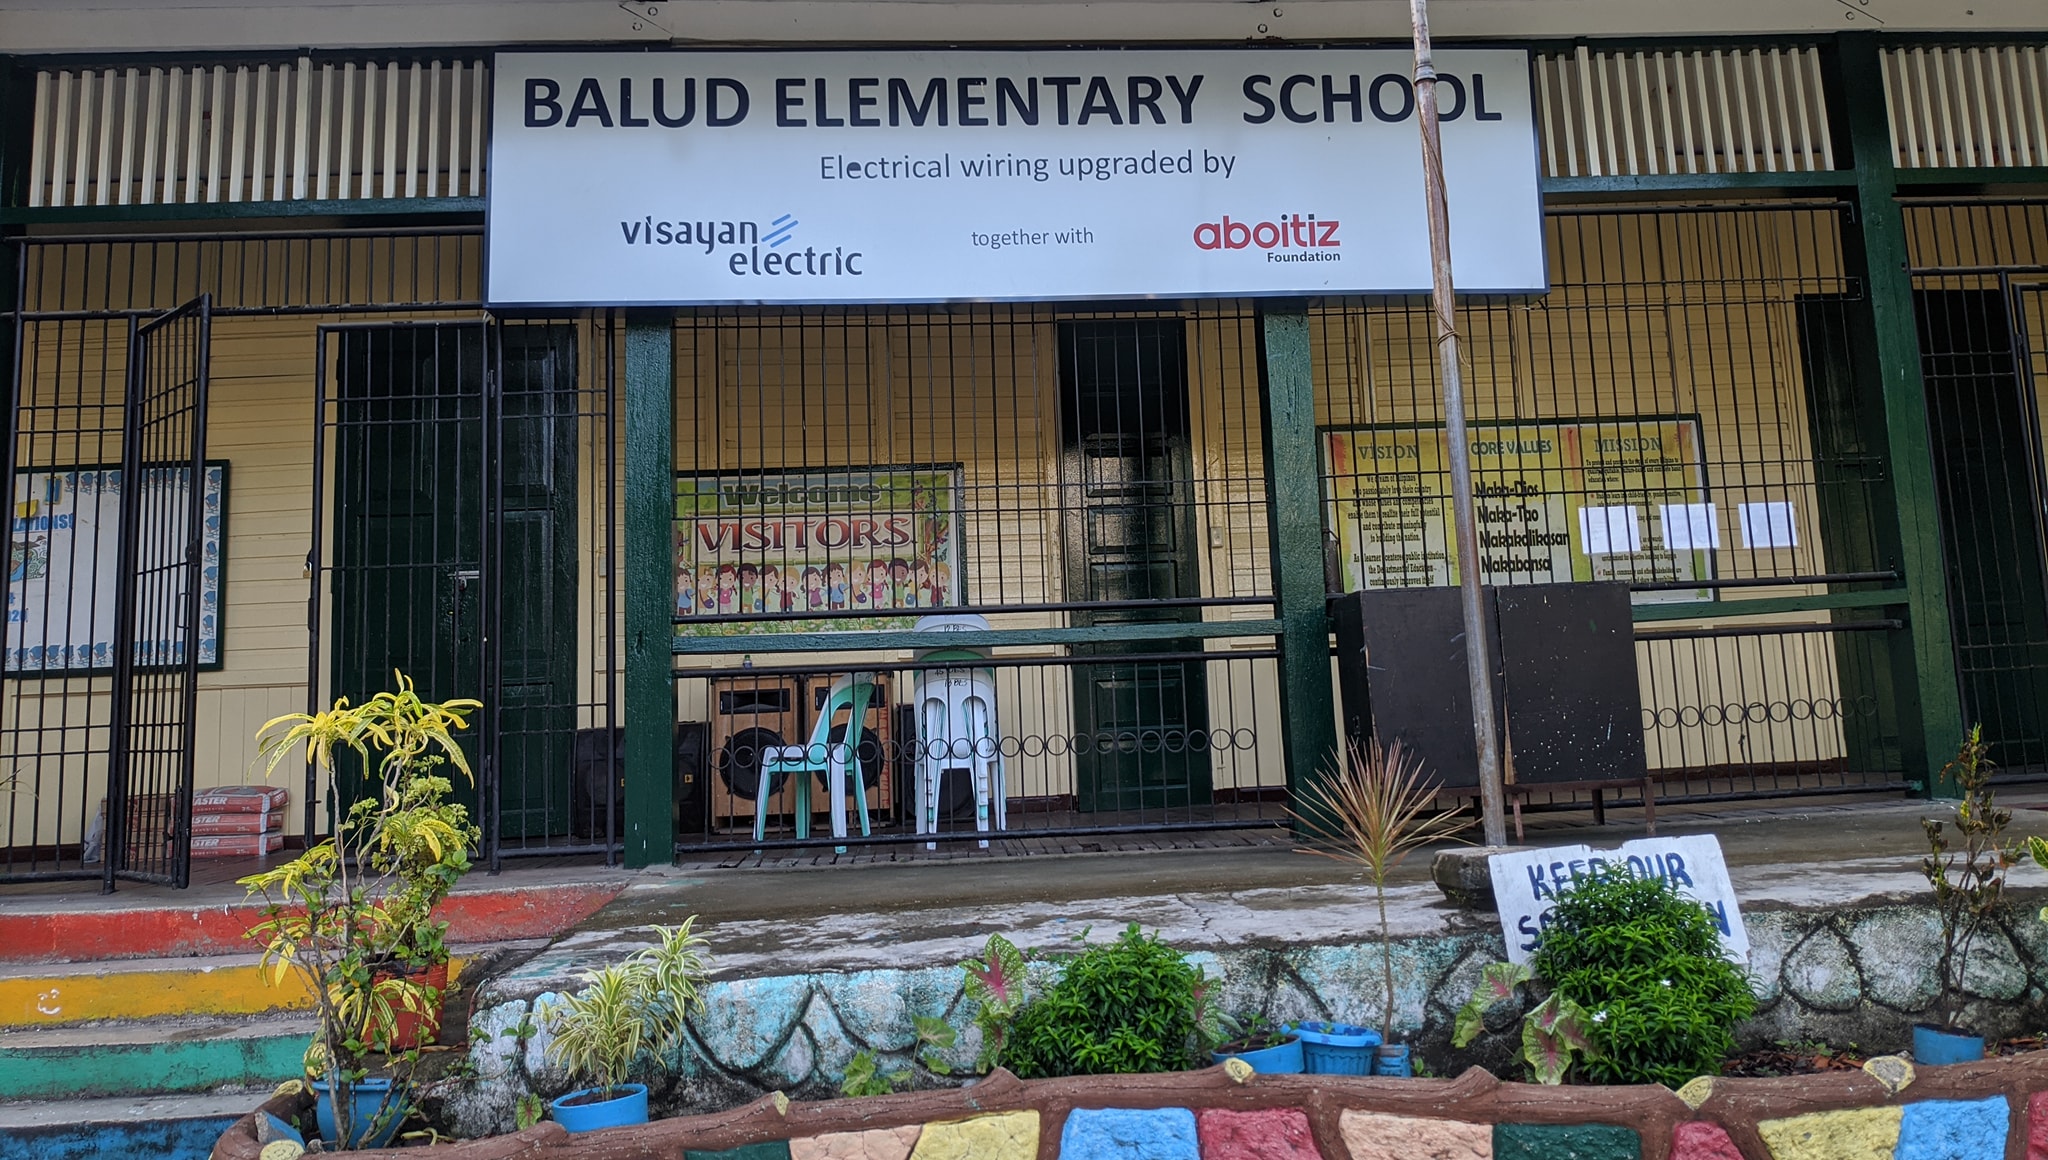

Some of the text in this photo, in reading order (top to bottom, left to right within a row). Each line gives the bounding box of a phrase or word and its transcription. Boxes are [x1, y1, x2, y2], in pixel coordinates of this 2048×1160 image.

[524, 73, 1503, 128] BALUD ELEMENTARY SCHOOL
[821, 149, 1236, 182] Electrical wiring upgraded by
[621, 215, 757, 255] visayan
[971, 227, 1094, 250] together with
[1193, 213, 1341, 250] aboitiz
[729, 246, 863, 276] electric
[1267, 250, 1341, 263] Foundation
[1358, 444, 1419, 460] VISION
[1471, 440, 1552, 455] CORE VALUES
[1594, 437, 1662, 453] MISSION
[723, 482, 882, 506] Welcome
[697, 518, 912, 552] VISITORS
[1372, 520, 1396, 531] conibute
[1375, 532, 1396, 544] bulding
[1369, 576, 1399, 588] continously
[1422, 574, 1435, 584] itelf
[194, 797, 228, 805] ASTER
[1627, 852, 1694, 890] OUR
